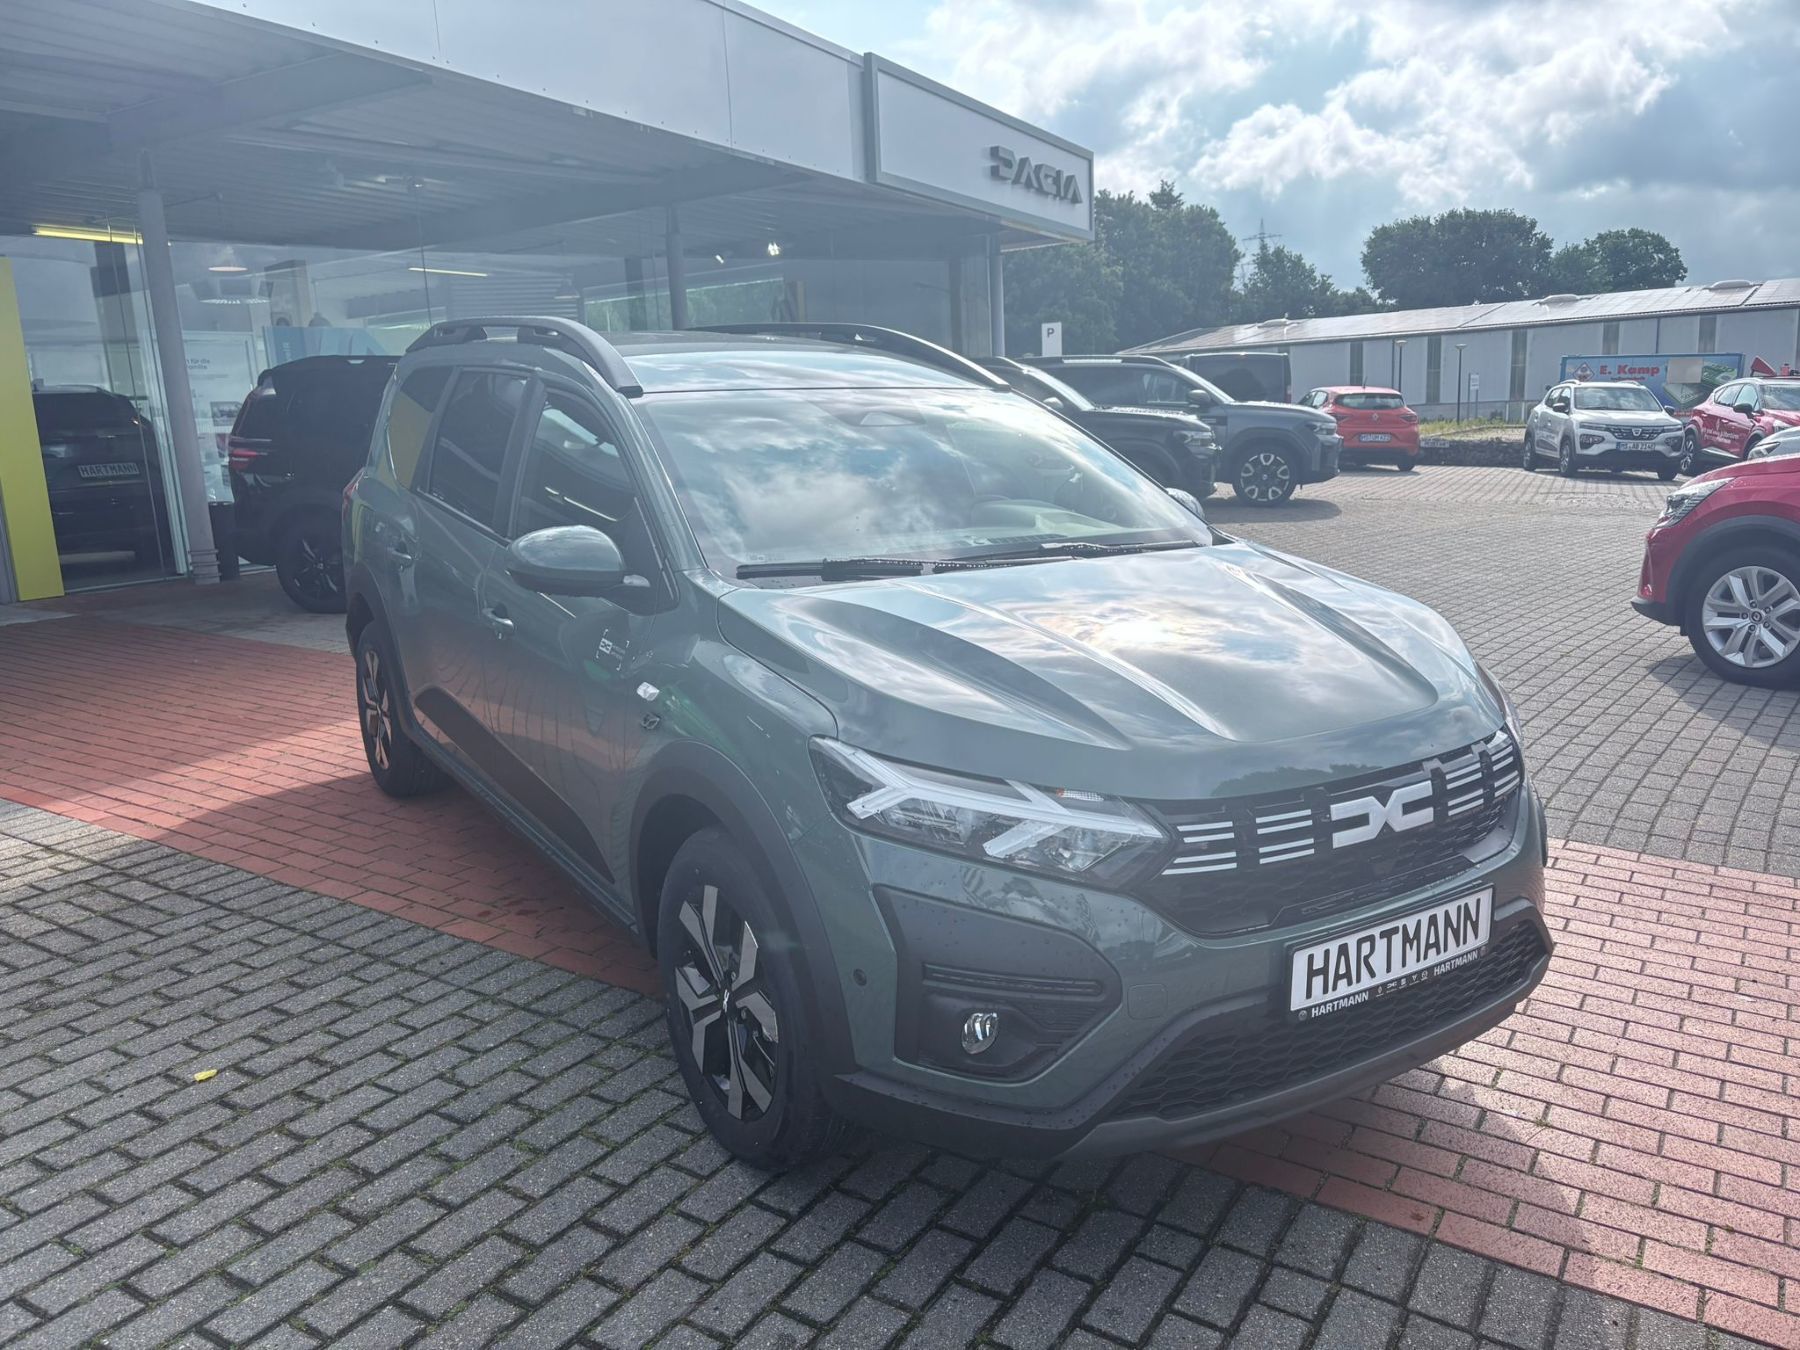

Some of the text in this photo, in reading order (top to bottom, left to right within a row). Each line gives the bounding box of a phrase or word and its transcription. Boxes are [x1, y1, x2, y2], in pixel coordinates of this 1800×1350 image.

[989, 145, 1083, 204] DACIA
[1047, 327, 1055, 338] P
[1599, 364, 1660, 376] E. Kamp
[79, 463, 138, 477] HARTMANN
[1305, 898, 1481, 1000] HARTMANN
[1434, 951, 1479, 977] HARTMANN
[1311, 991, 1369, 1019] HARTMANN
